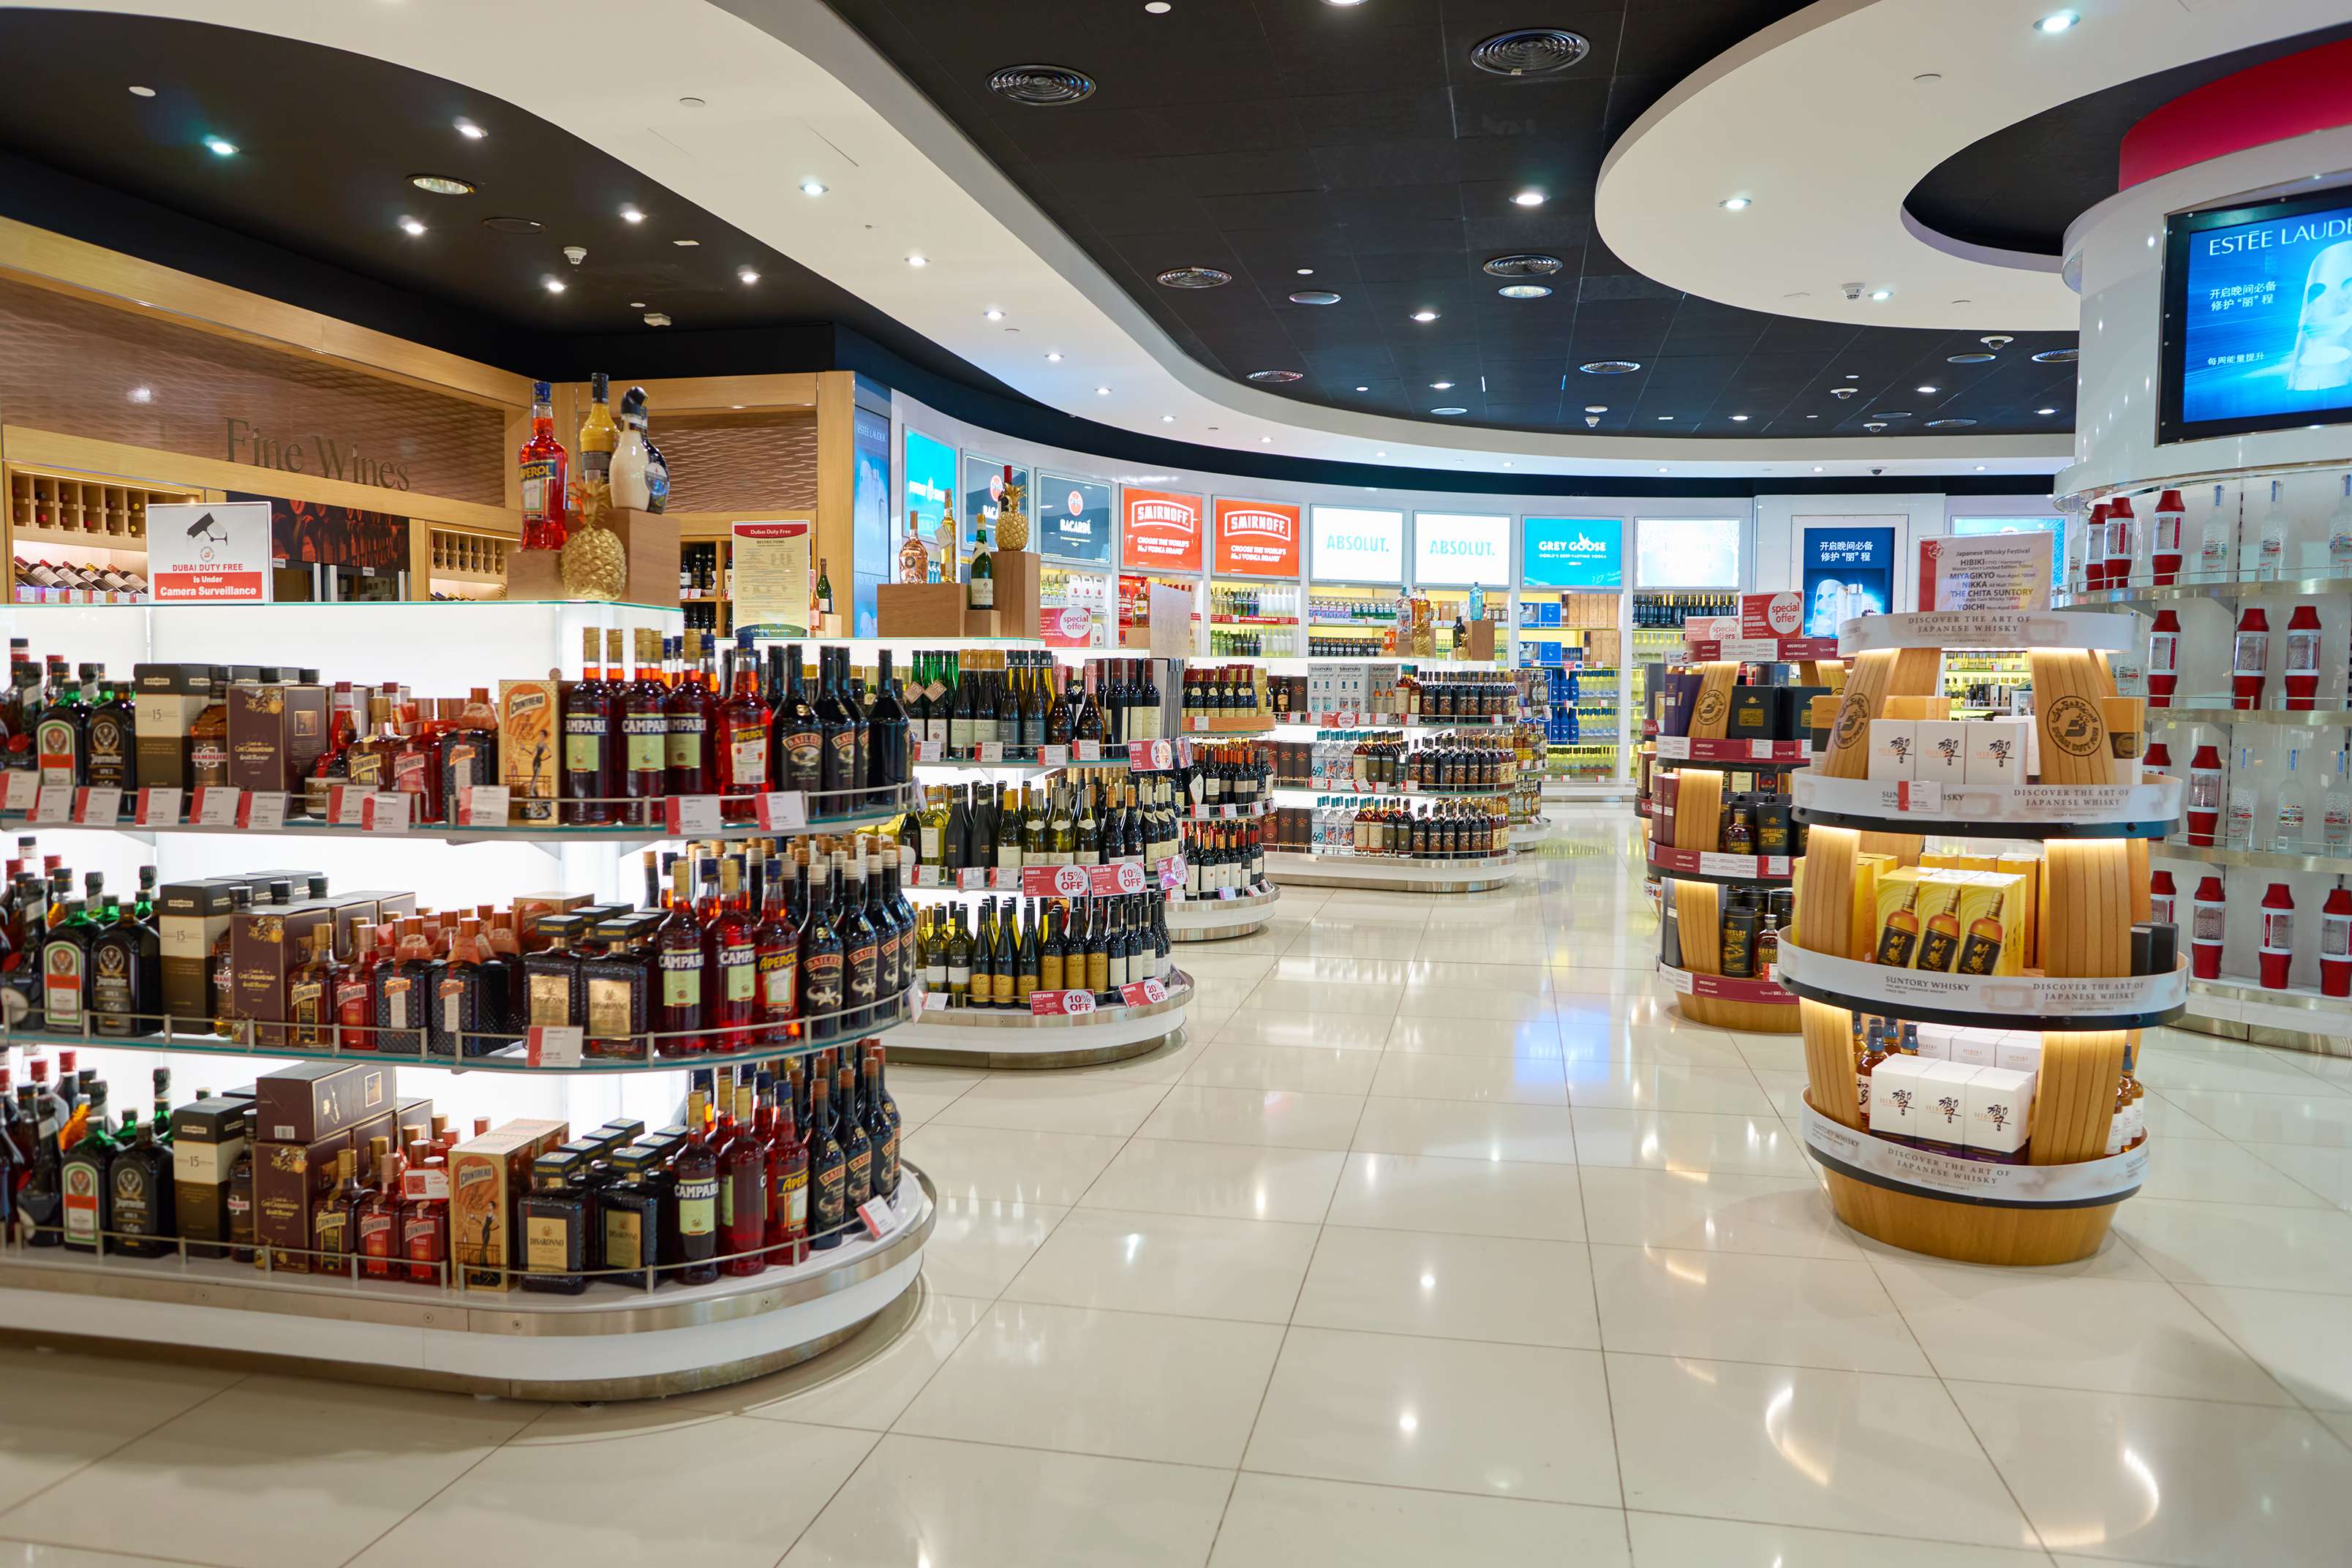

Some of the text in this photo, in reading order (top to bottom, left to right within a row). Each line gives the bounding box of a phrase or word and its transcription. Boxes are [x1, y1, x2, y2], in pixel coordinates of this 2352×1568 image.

[2209, 281, 2277, 300] 开启晚间必备
[223, 416, 411, 492] Fine Wines
[520, 465, 551, 480] PEROL
[983, 504, 999, 520] BACA
[1538, 540, 1606, 551] GREY GOOSE
[1820, 540, 1874, 551] 开启晚间必备
[173, 563, 243, 572] DUBAI DUTY FREE
[1960, 559, 1985, 567] HIBIKI
[1949, 572, 1995, 580] MIYAGIKYO
[159, 585, 257, 596] Camera Surveillance
[1967, 589, 1991, 598] CHITA
[1994, 588, 2034, 596] SUNTORY
[1772, 602, 1800, 615] special
[1063, 614, 1089, 625] special
[1776, 614, 1796, 623] offer
[1908, 615, 2031, 625] DISCOVER THE ART OF
[1712, 625, 1738, 636] special
[1918, 625, 2019, 633] JAPANESE WHISKY
[1714, 632, 1735, 640] offers
[511, 692, 545, 716] COINTREAU
[152, 709, 162, 720] 15
[566, 720, 606, 733] AMPARI
[622, 720, 668, 733] CAMPAR
[1943, 794, 1965, 802] ISKY
[1060, 871, 1084, 881] 15%
[1122, 868, 1142, 878] 10%
[1061, 881, 1083, 890] OFF
[1123, 878, 1142, 887] OFF
[176, 930, 186, 941] 15
[1758, 947, 1777, 955] ABERF
[1885, 976, 1971, 991] SUNTORY WHISKY
[2033, 982, 2087, 990] DISCOVER
[1068, 994, 1091, 1003] 10%
[1151, 992, 1166, 1001] OFF
[2045, 992, 2136, 1001] JAPANESE WHISKY
[1070, 1003, 1091, 1011] OFF
[1833, 1133, 1860, 1148] WHISKY
[189, 1155, 200, 1167] 15
[1887, 1147, 2011, 1177] DISCOVER THE ART OF
[460, 1167, 492, 1188] COINTREAU
[1896, 1160, 1998, 1185] JAPANESE WHISKY
[783, 1171, 809, 1192] APER
[317, 1214, 345, 1232] COINTREAU
[361, 1218, 391, 1237] COINTREAU
[406, 1221, 434, 1240] COINTREAU
[529, 1237, 565, 1248] DISARONNO
